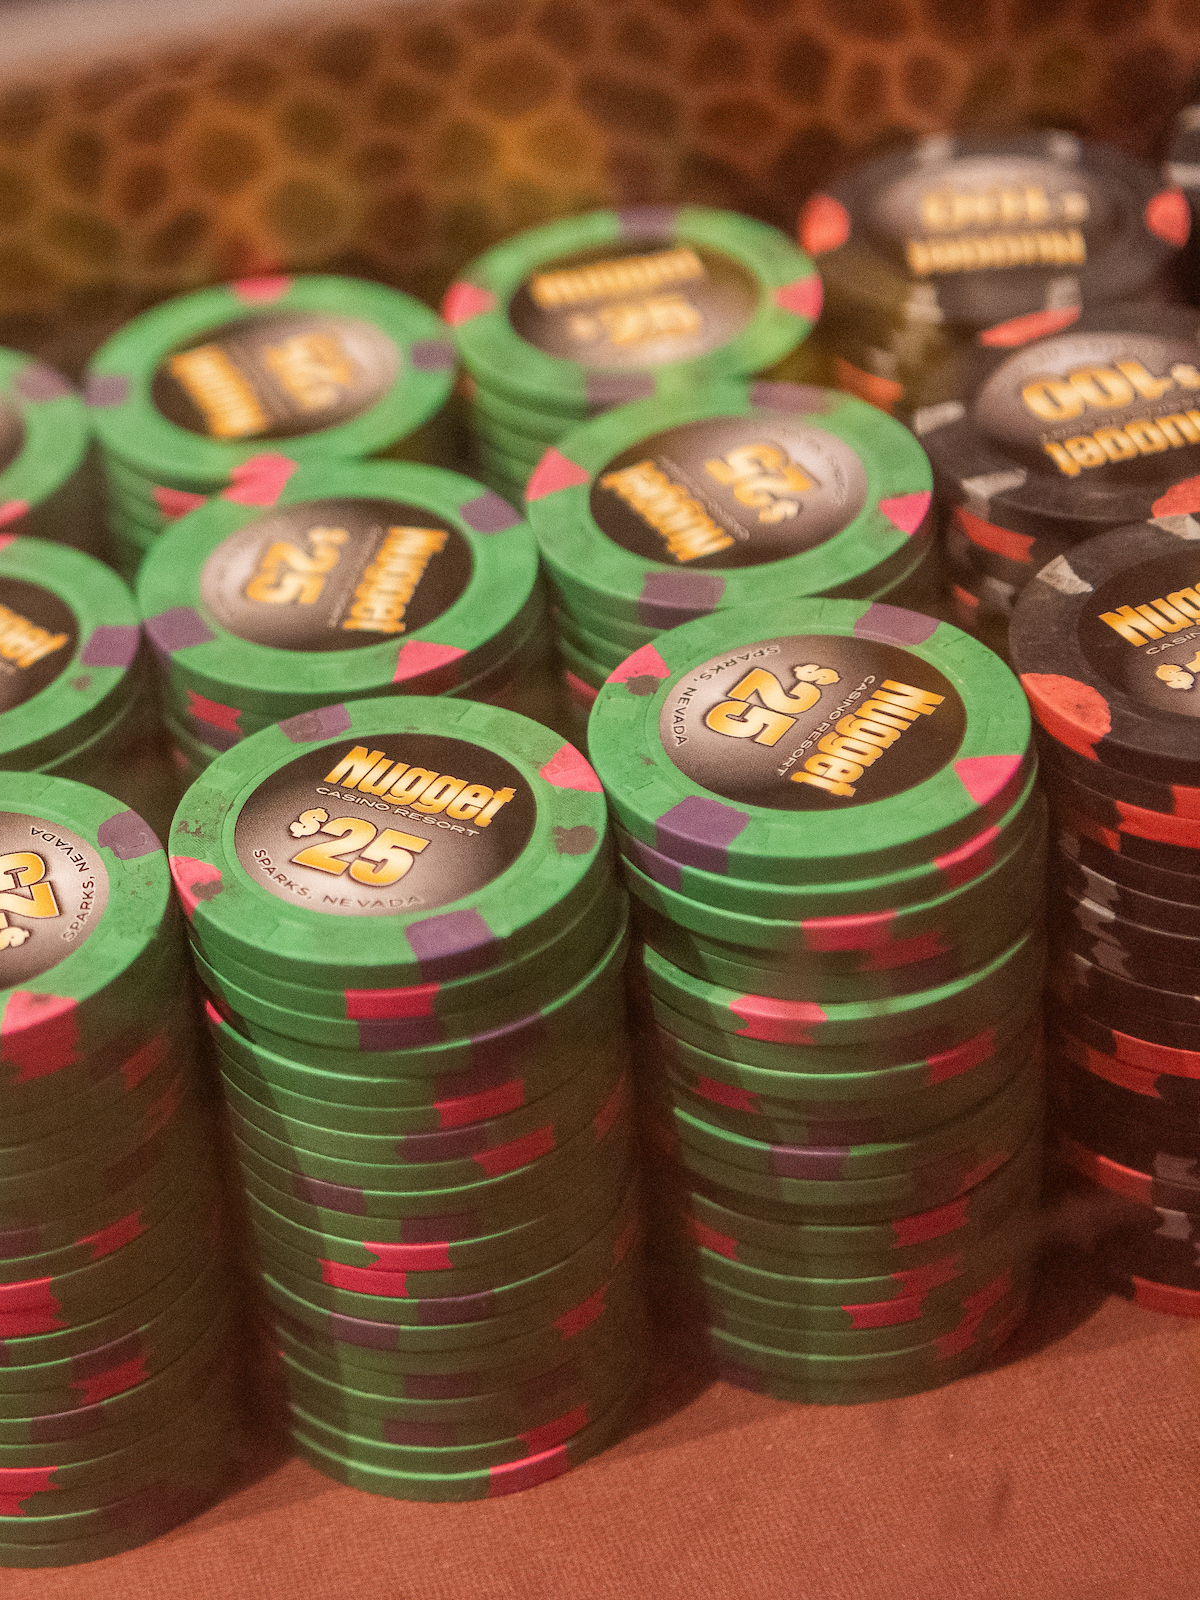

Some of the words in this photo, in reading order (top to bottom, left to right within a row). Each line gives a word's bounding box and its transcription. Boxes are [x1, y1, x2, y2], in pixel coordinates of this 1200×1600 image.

[705, 444, 812, 523] $25
[248, 528, 348, 605] $25
[343, 526, 448, 632] Nugget
[692, 645, 779, 683] SPARKS,
[829, 674, 876, 721] CASINO
[672, 685, 698, 746] NEVADA
[705, 663, 842, 748] $25
[790, 679, 946, 798] Nugget
[777, 721, 828, 777] RESORT
[316, 787, 390, 812] CASINO
[393, 808, 480, 838] RESORT
[323, 745, 518, 828] Nugget
[29, 826, 90, 873] NEVADA
[252, 849, 313, 900] SPARKS,
[322, 894, 426, 909] NEVADA
[289, 806, 431, 887] $25
[62, 875, 97, 943] SPARKS,
